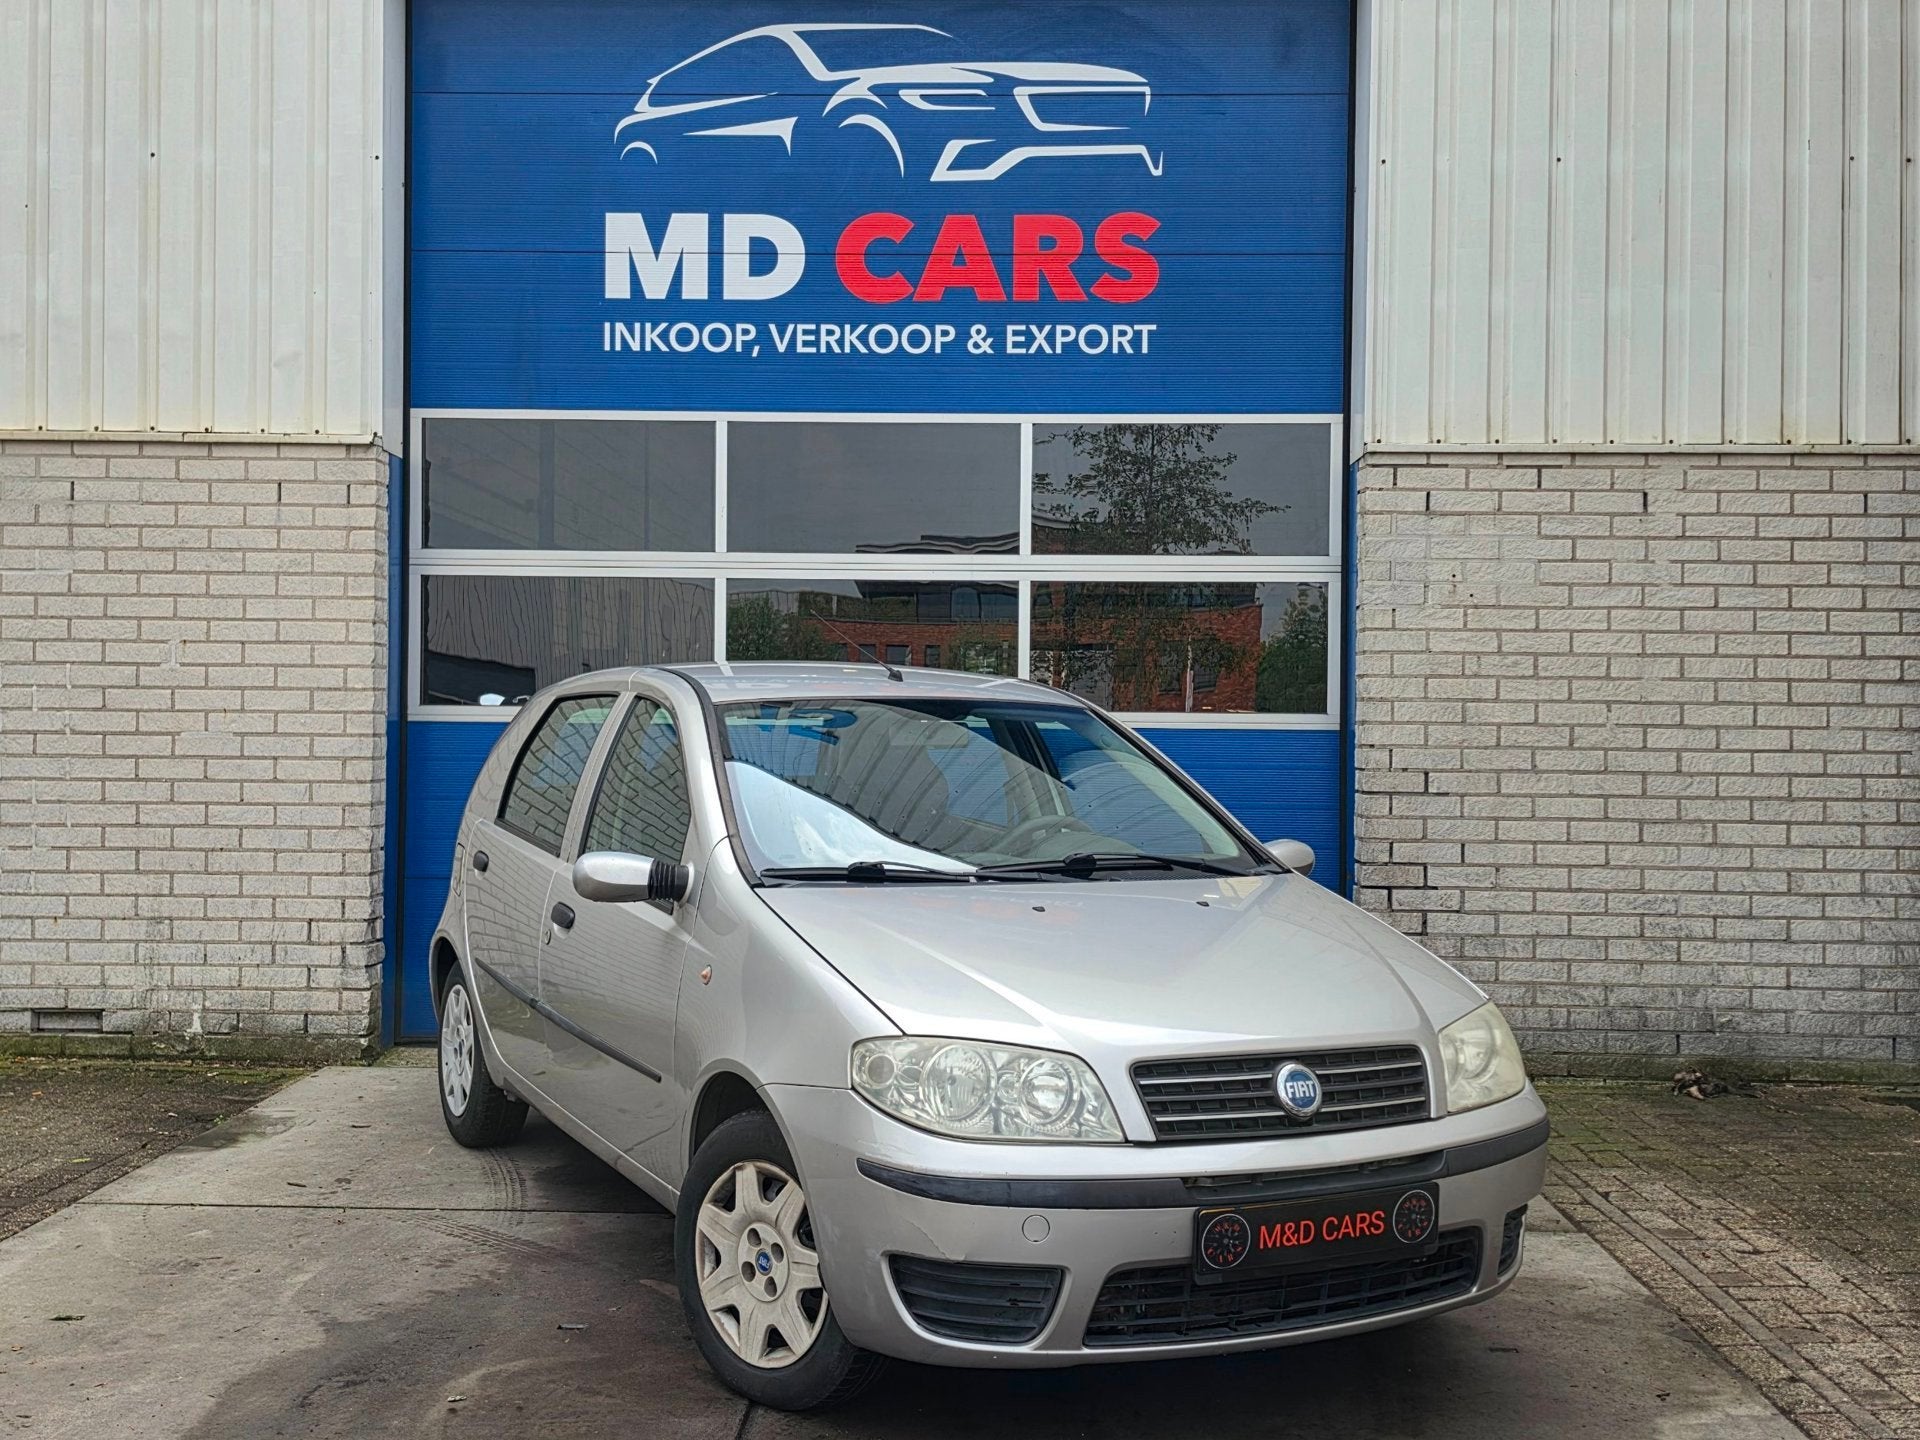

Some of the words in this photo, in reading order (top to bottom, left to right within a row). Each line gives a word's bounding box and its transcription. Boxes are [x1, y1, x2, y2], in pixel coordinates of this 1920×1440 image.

[604, 212, 806, 300] MD
[835, 212, 1161, 303] CARS
[603, 321, 760, 357] INKOOP,
[768, 323, 956, 354] VERKOOP
[967, 323, 994, 354] &
[1005, 324, 1158, 354] EXPORT
[1285, 1080, 1315, 1099] FIAT
[1259, 1220, 1315, 1249] M&D
[1322, 1210, 1385, 1241] CARS
